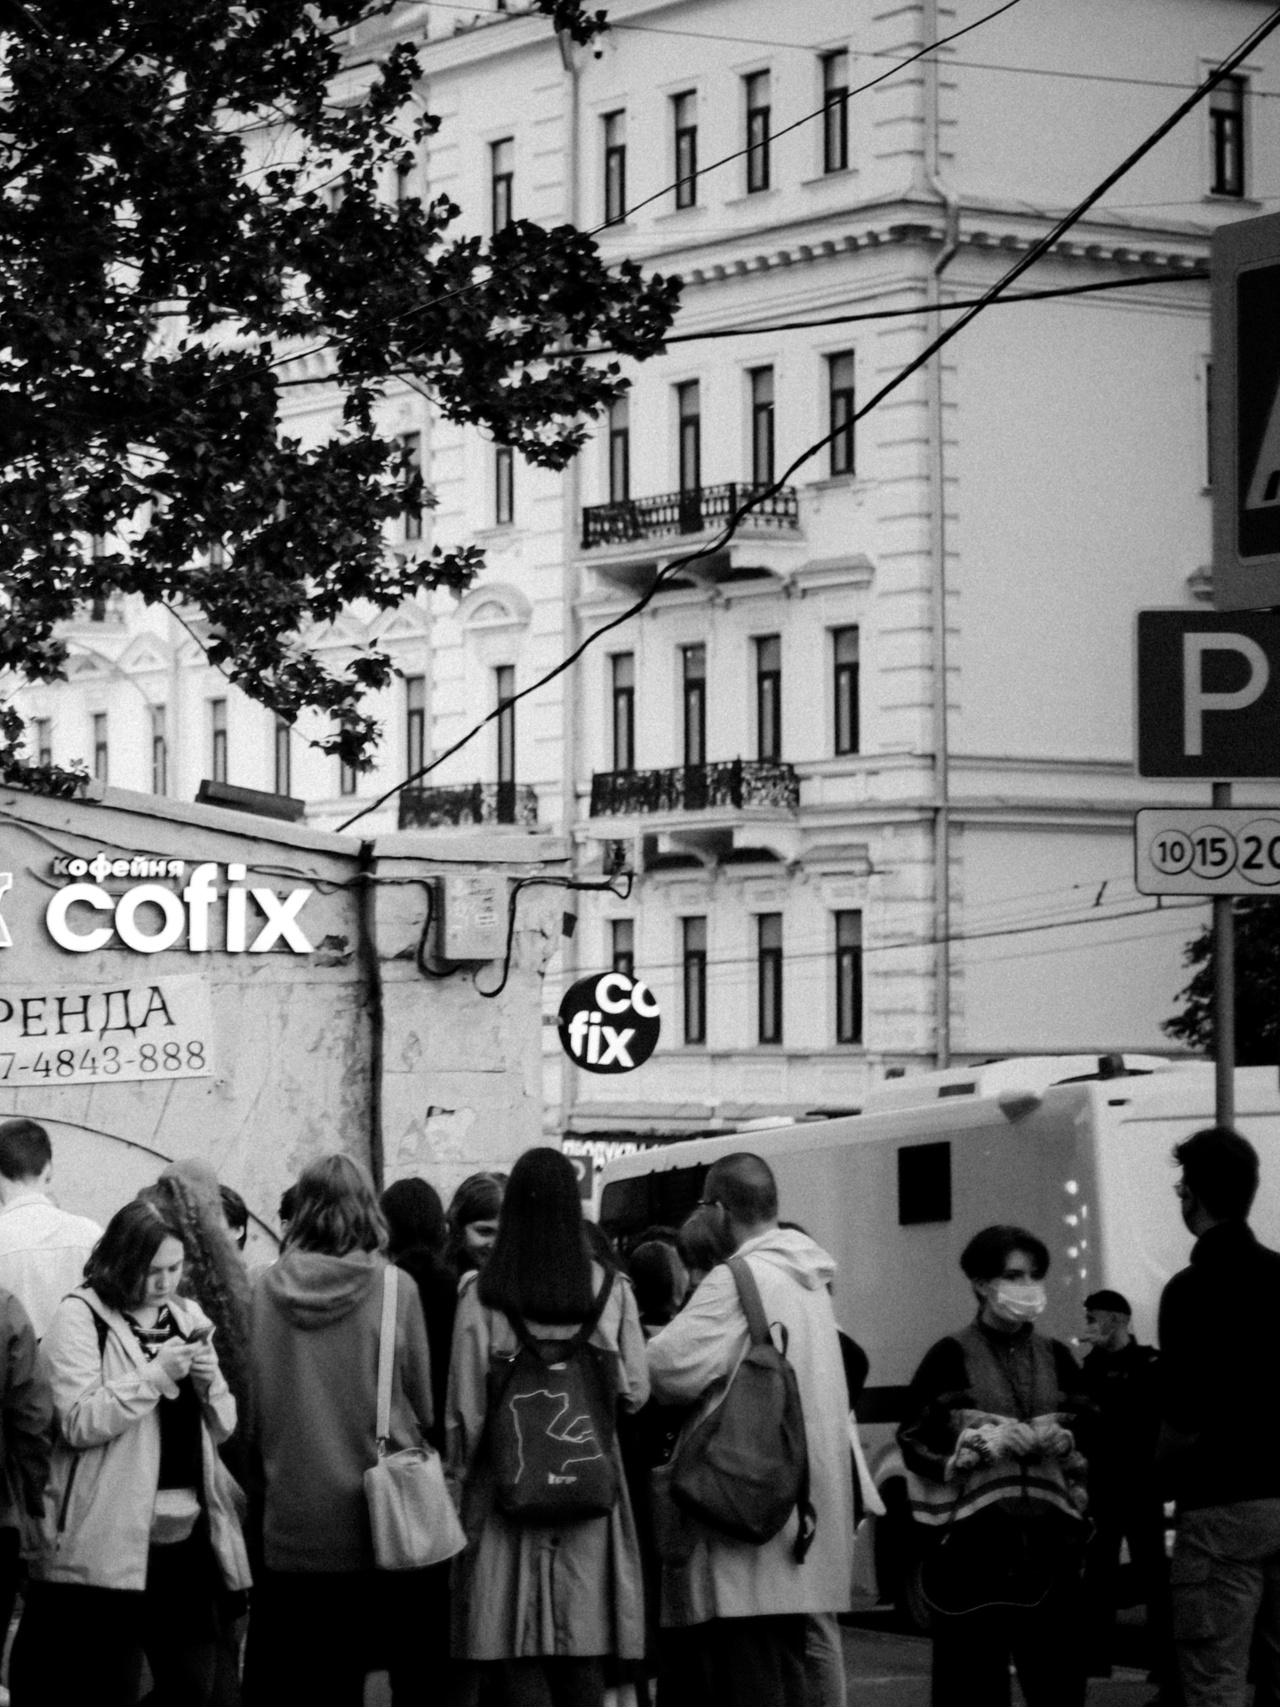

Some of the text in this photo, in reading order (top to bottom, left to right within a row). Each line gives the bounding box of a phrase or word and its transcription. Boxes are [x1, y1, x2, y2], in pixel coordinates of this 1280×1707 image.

[1183, 632, 1270, 756] P
[53, 852, 185, 883] кофейня
[1157, 841, 1185, 863] 10
[1196, 837, 1228, 867] 15
[45, 862, 316, 954] cofix
[568, 1010, 636, 1067] fix
